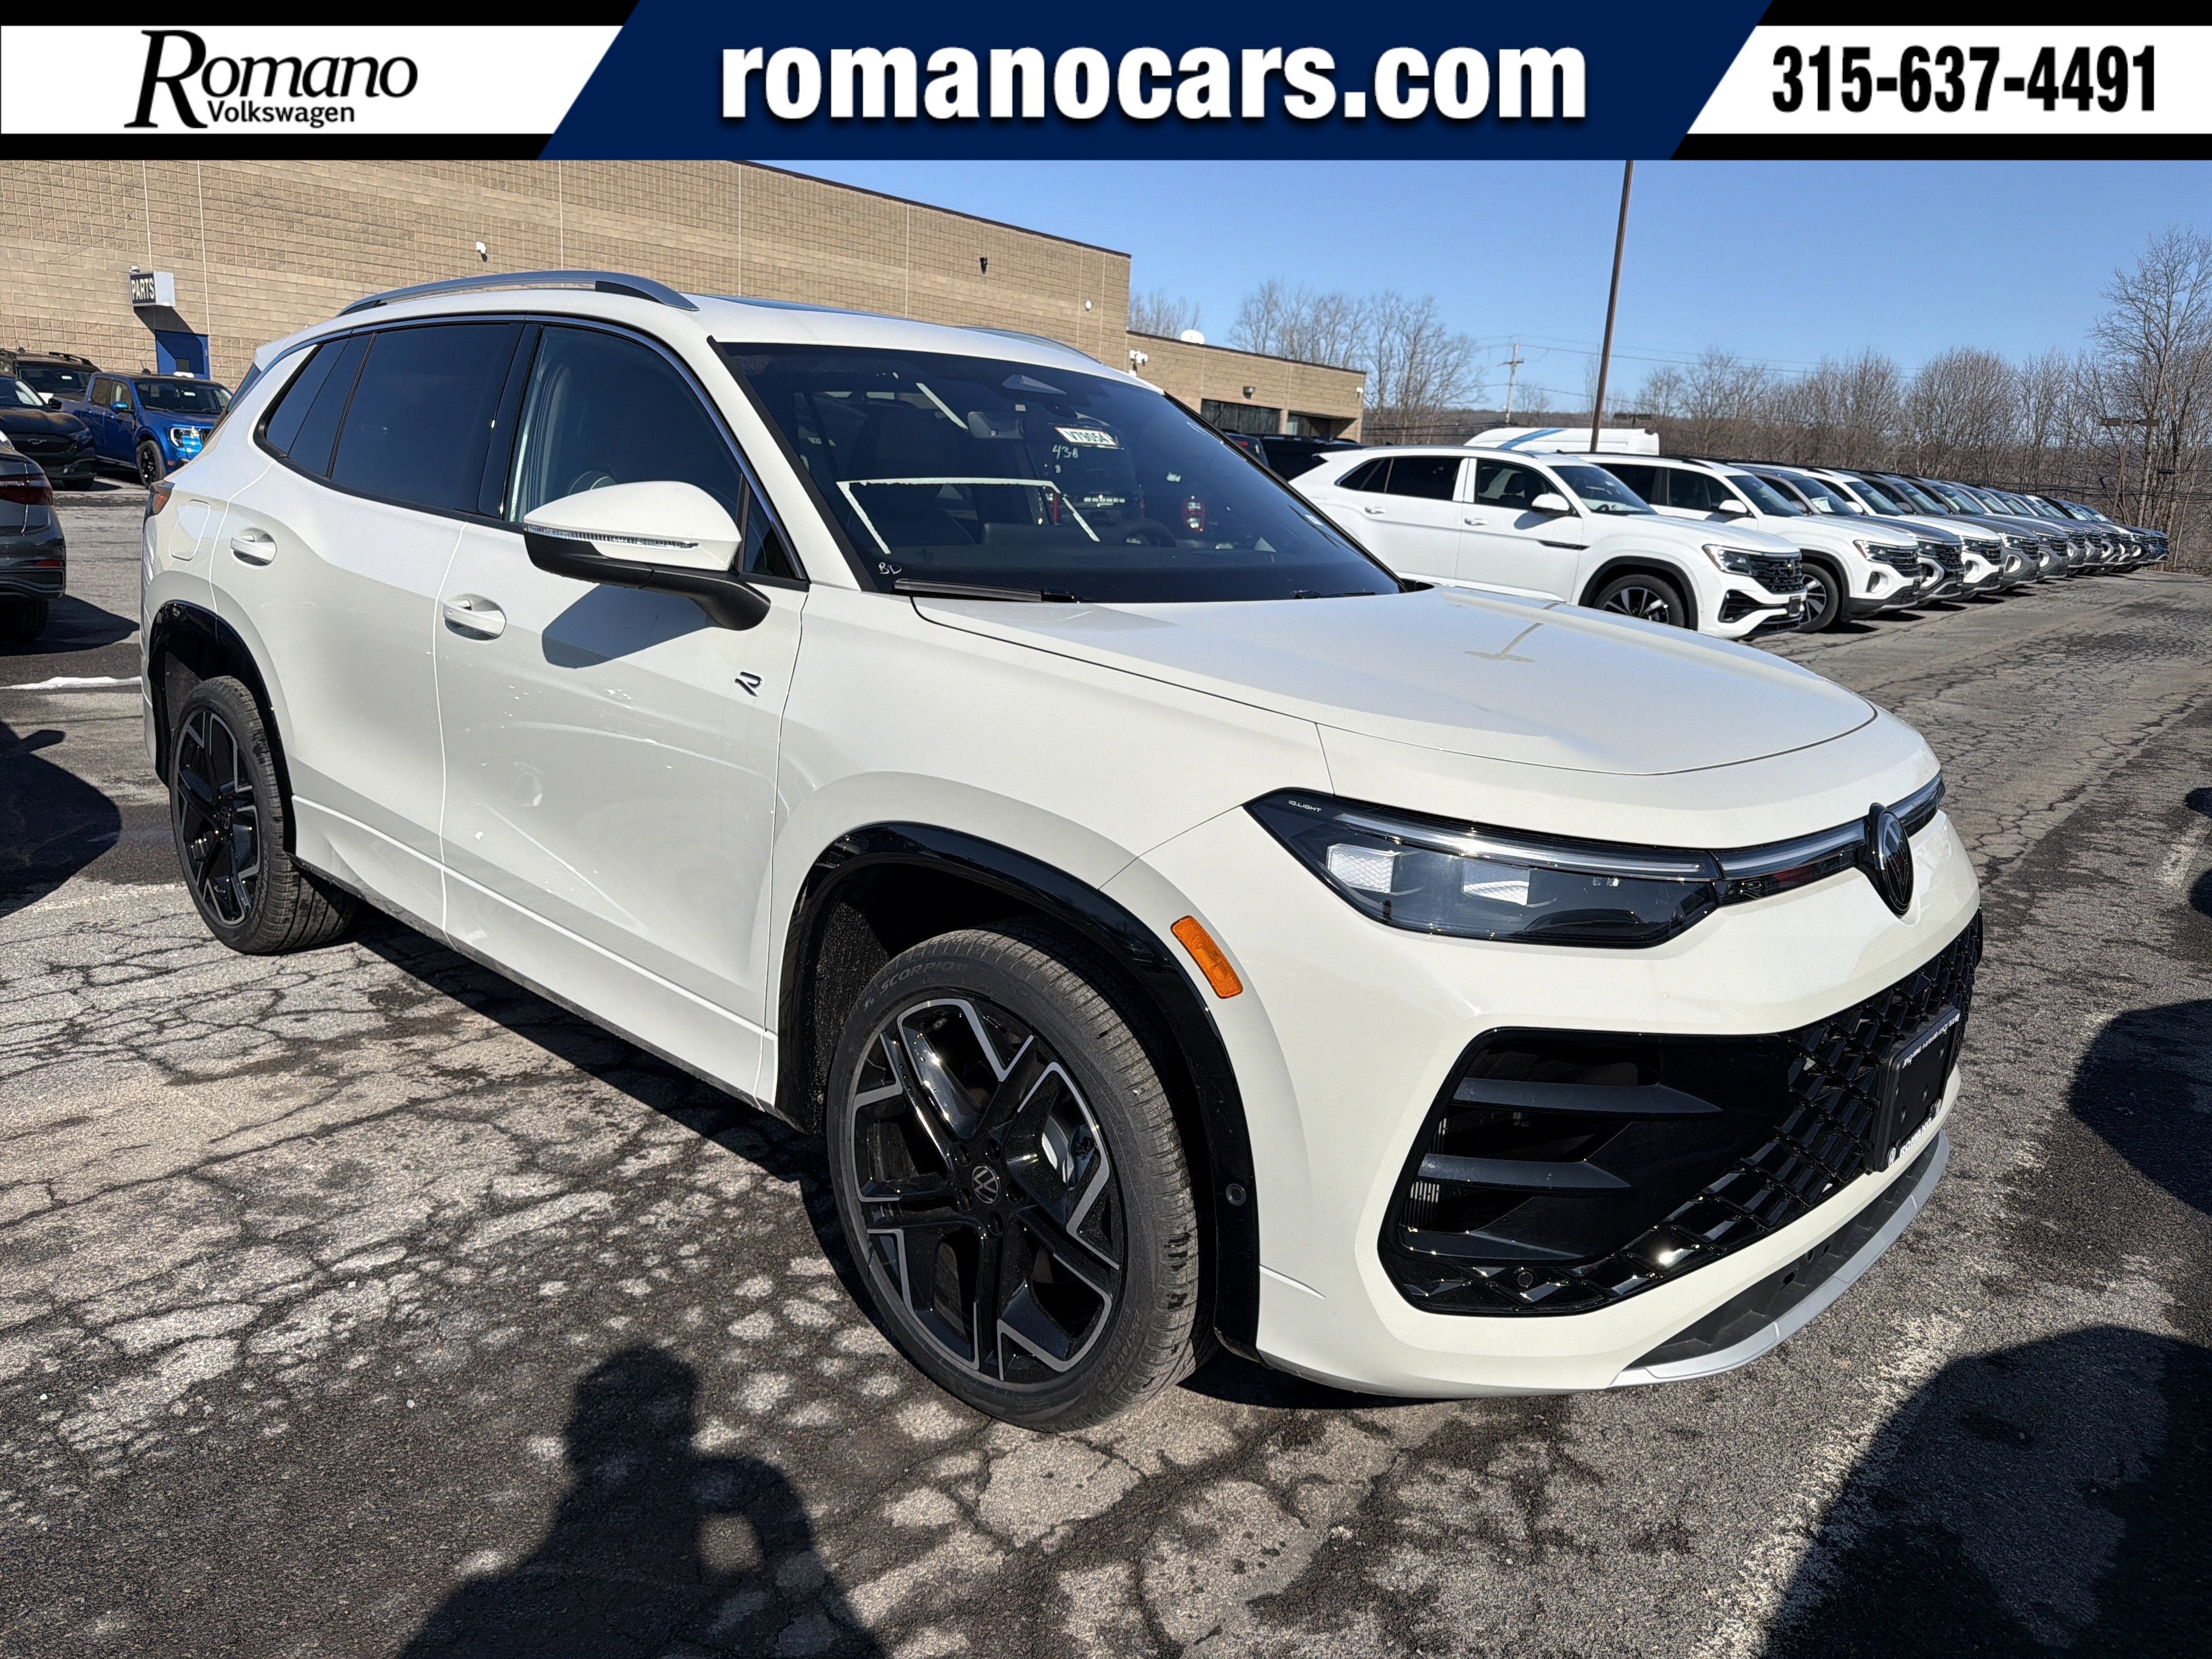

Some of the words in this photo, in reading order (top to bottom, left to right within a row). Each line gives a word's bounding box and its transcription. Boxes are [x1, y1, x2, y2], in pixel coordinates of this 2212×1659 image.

[131, 278, 155, 301] PARTS
[1288, 800, 1322, 812] IQ.LIGHT
[879, 961, 969, 995] SCORPION
